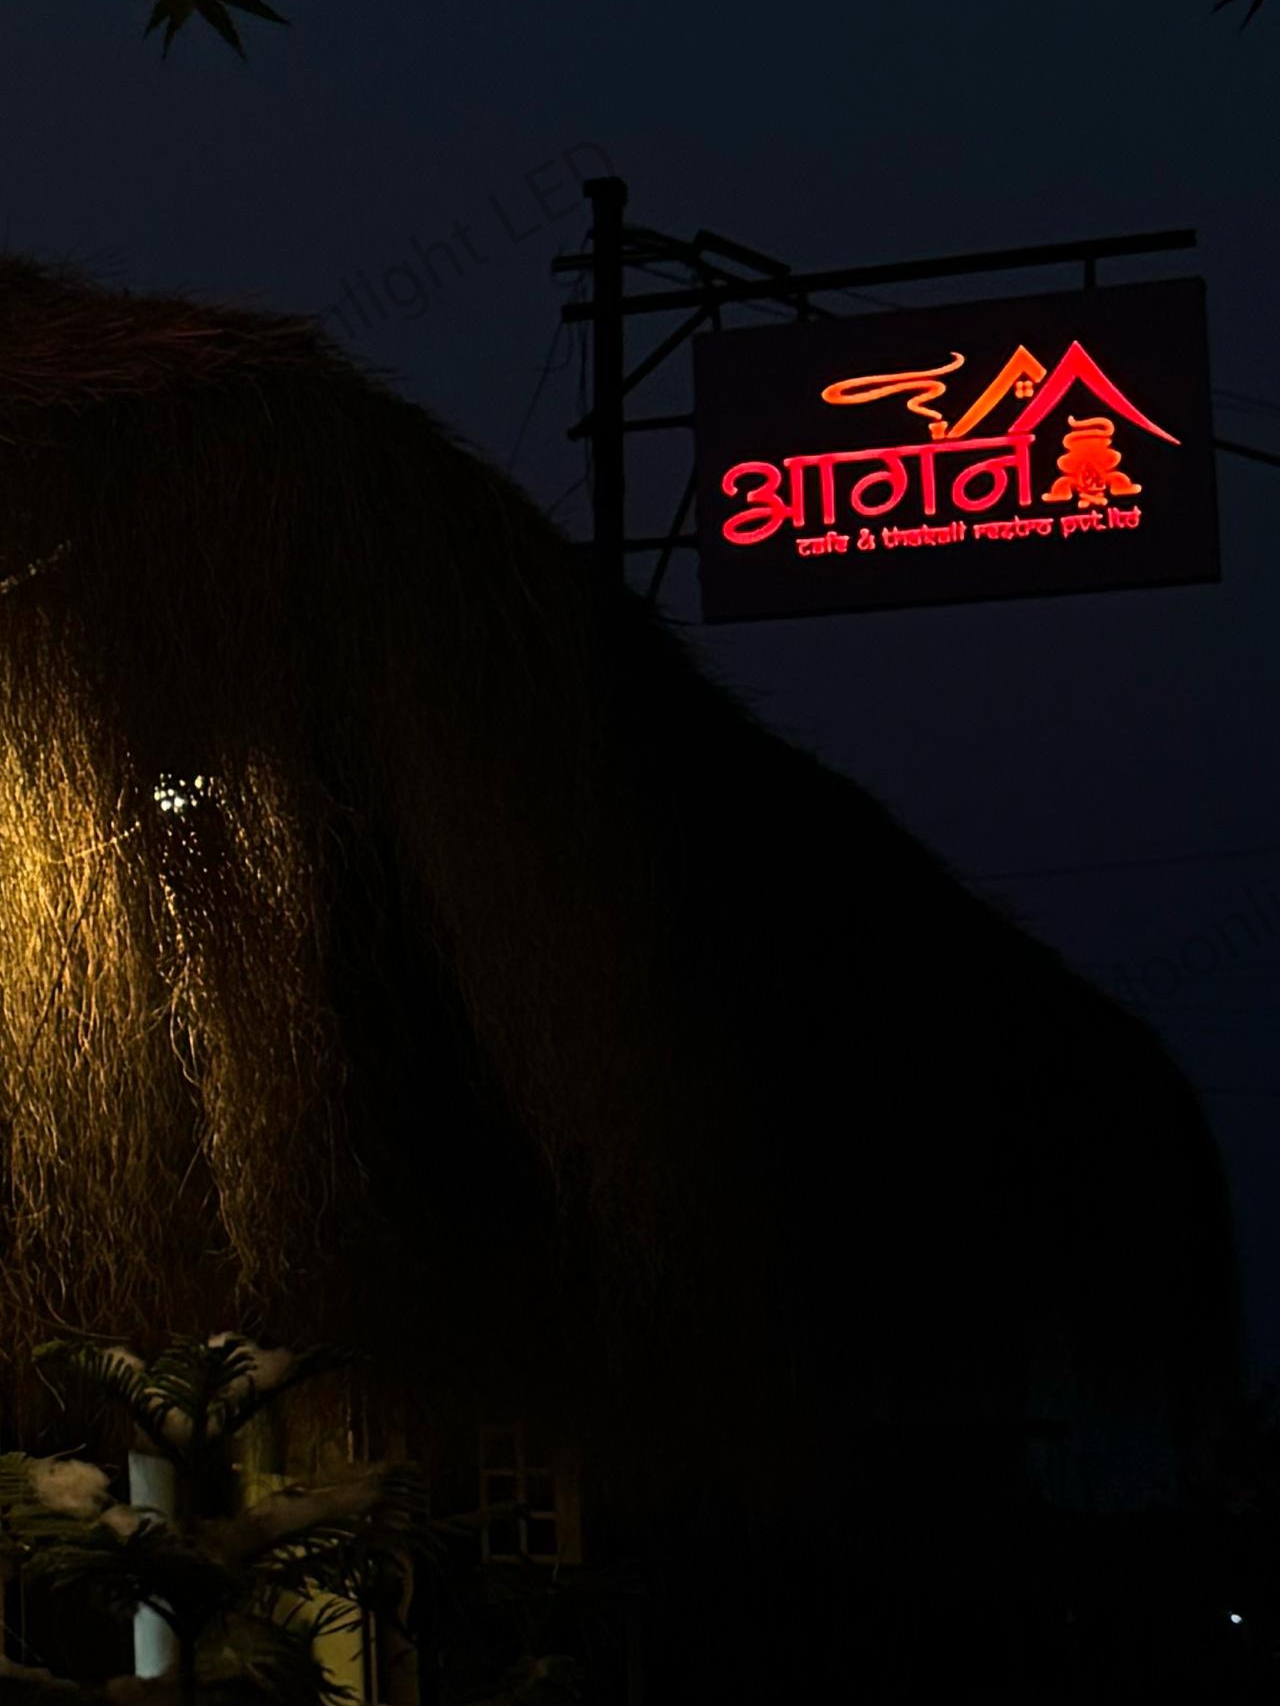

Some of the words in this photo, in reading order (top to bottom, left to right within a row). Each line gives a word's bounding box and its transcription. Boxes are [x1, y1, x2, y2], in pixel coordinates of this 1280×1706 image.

[796, 531, 850, 556] cafe
[857, 528, 876, 550] &
[882, 520, 967, 548] thakali
